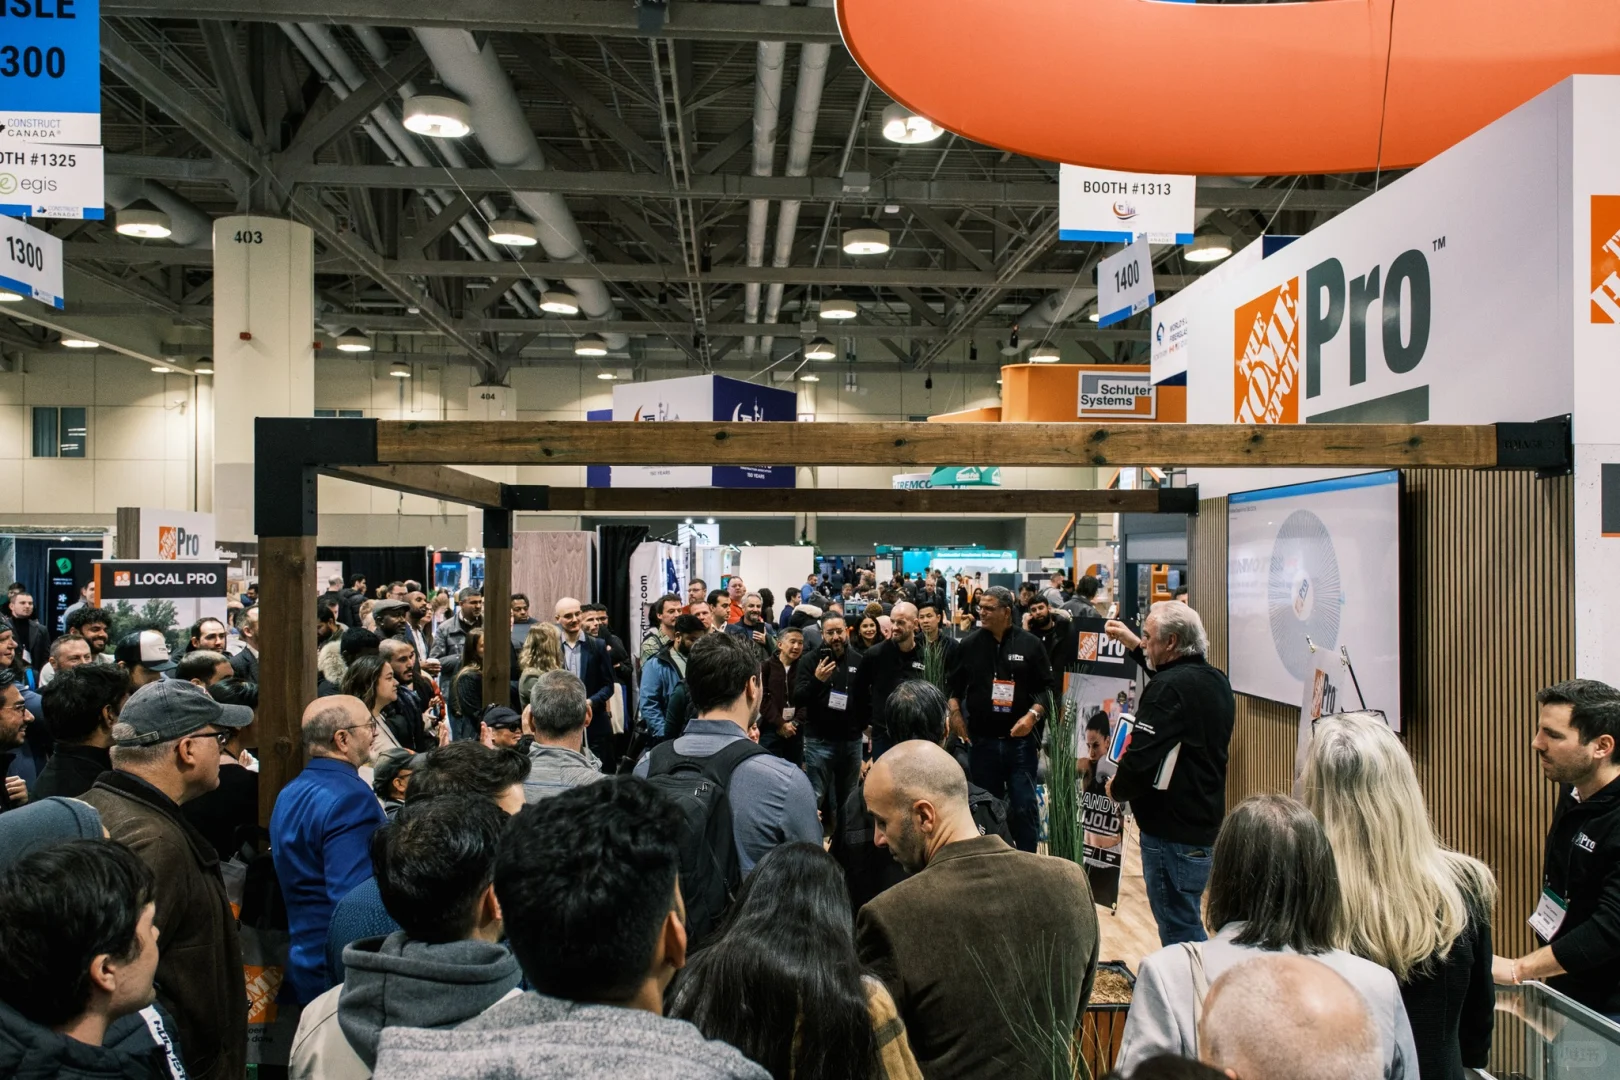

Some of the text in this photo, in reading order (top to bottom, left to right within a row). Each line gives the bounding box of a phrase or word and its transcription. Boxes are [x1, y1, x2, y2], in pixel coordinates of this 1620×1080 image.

[7, 118, 61, 129] CONSTRUCT
[30, 153, 76, 168] #1325
[21, 176, 58, 194] egis
[1083, 181, 1171, 196] BOOTH #1313
[234, 230, 263, 244] 403
[6, 236, 43, 272] 1300
[1114, 259, 1140, 293] 1400
[1306, 248, 1432, 400] Pro
[480, 392, 496, 401] 404
[1101, 384, 1152, 396] Schluter
[1080, 394, 1133, 408] Systems
[177, 527, 200, 556] Pro
[134, 572, 217, 585] LOCAL PRO
[1098, 632, 1126, 657] Pro
[1320, 672, 1337, 714] Pro
[1077, 791, 1120, 815] ANDY
[1580, 833, 1596, 849] Pro
[247, 1027, 268, 1035] oers
